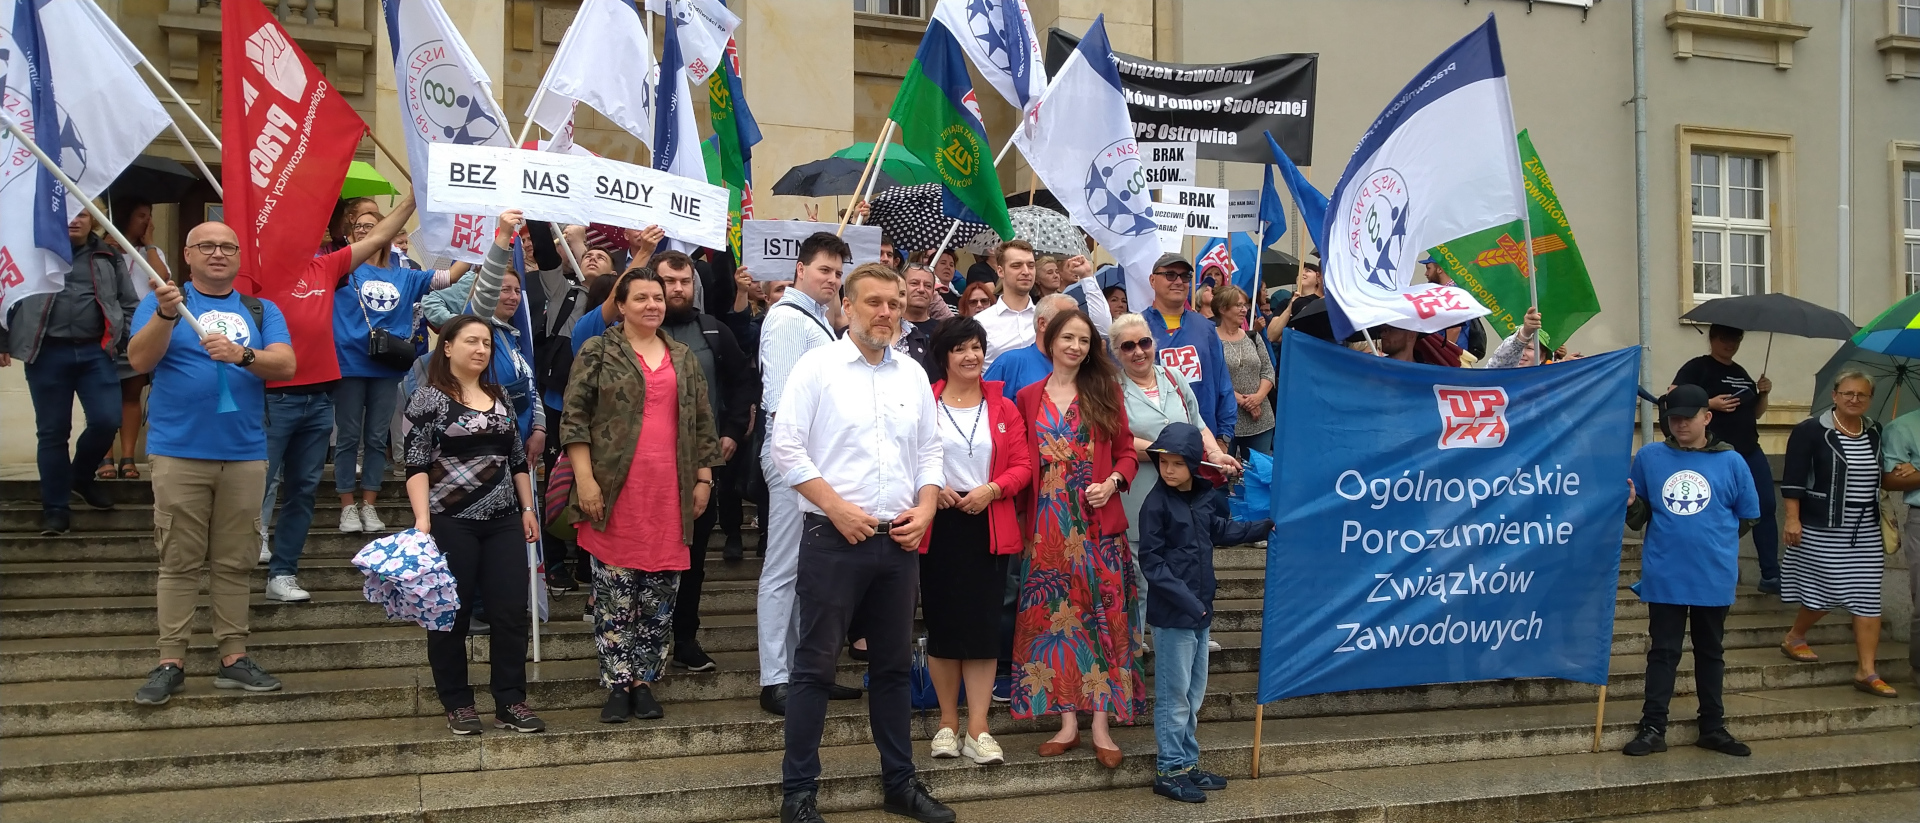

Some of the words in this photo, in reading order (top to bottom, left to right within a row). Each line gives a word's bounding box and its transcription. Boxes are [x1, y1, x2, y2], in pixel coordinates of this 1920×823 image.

[1113, 59, 1173, 80] wiązek
[1174, 67, 1255, 85] zawodowy
[1158, 93, 1221, 114] Pomocy
[1223, 96, 1308, 118] Społecznej
[1157, 123, 1238, 146] Ostrowina
[1152, 147, 1185, 162] BRAK
[449, 162, 497, 186] BEZ
[522, 168, 571, 194] NAS
[670, 192, 702, 217] NIE
[1145, 165, 1188, 183] SŁÓW...
[1179, 191, 1216, 209] BRAK
[1436, 243, 1501, 318] zeczypospolitej
[1334, 463, 1580, 510] Ogólnopolskie
[1340, 514, 1574, 555] Porozumienie
[1366, 562, 1535, 604] Związków
[1333, 610, 1543, 654] Zawodowych
